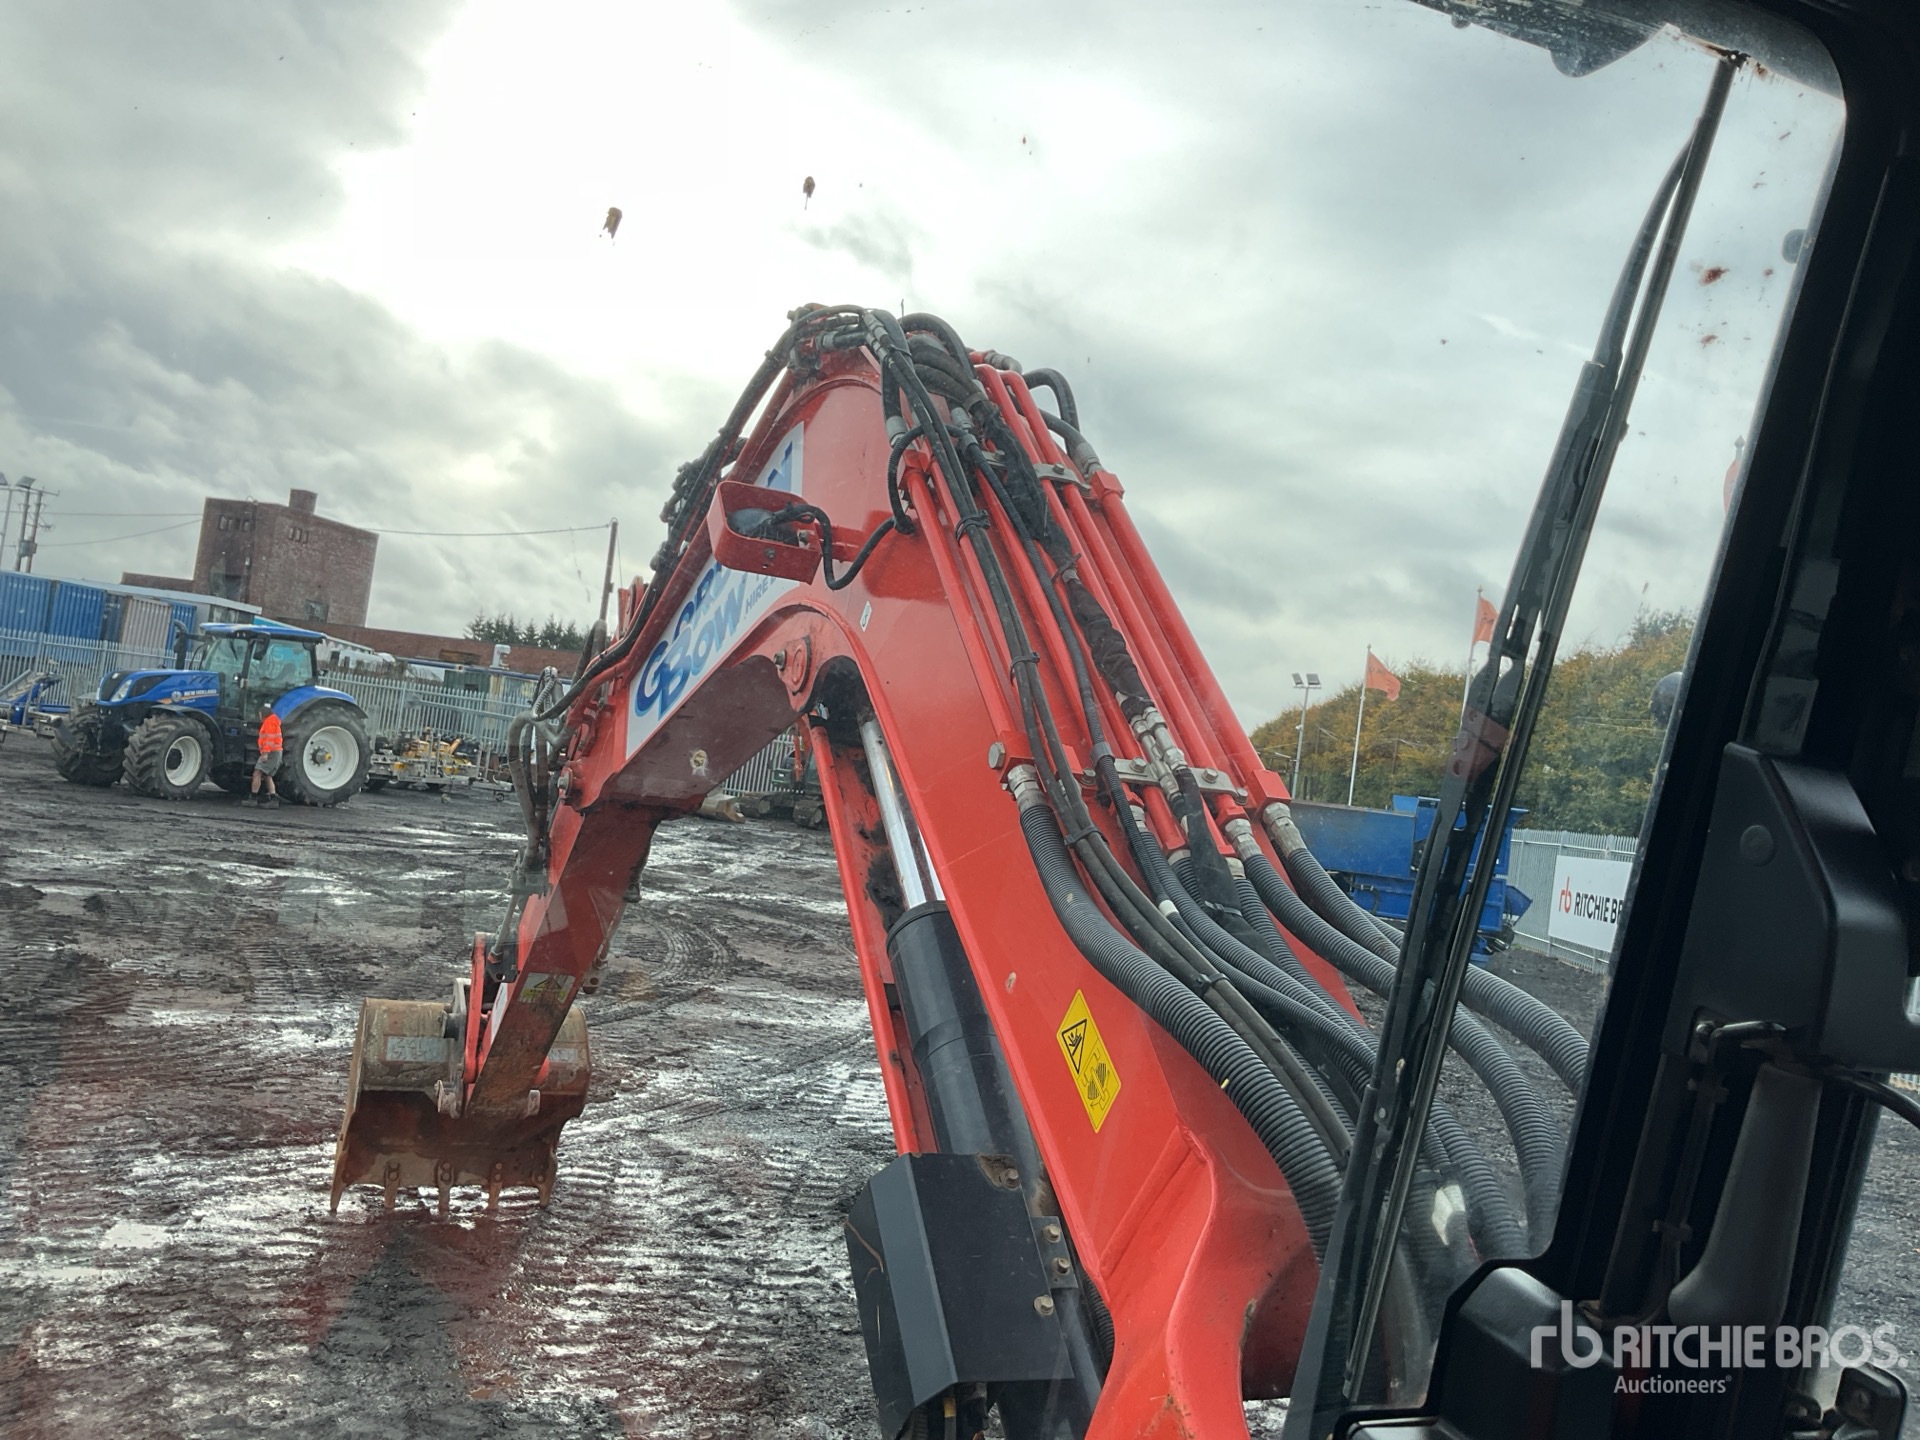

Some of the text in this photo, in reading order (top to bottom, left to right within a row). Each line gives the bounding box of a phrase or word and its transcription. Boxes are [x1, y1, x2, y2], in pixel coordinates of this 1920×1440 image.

[745, 580, 769, 614] HIRE
[658, 571, 748, 721] BOW
[1574, 892, 1610, 922] RITCHIE
